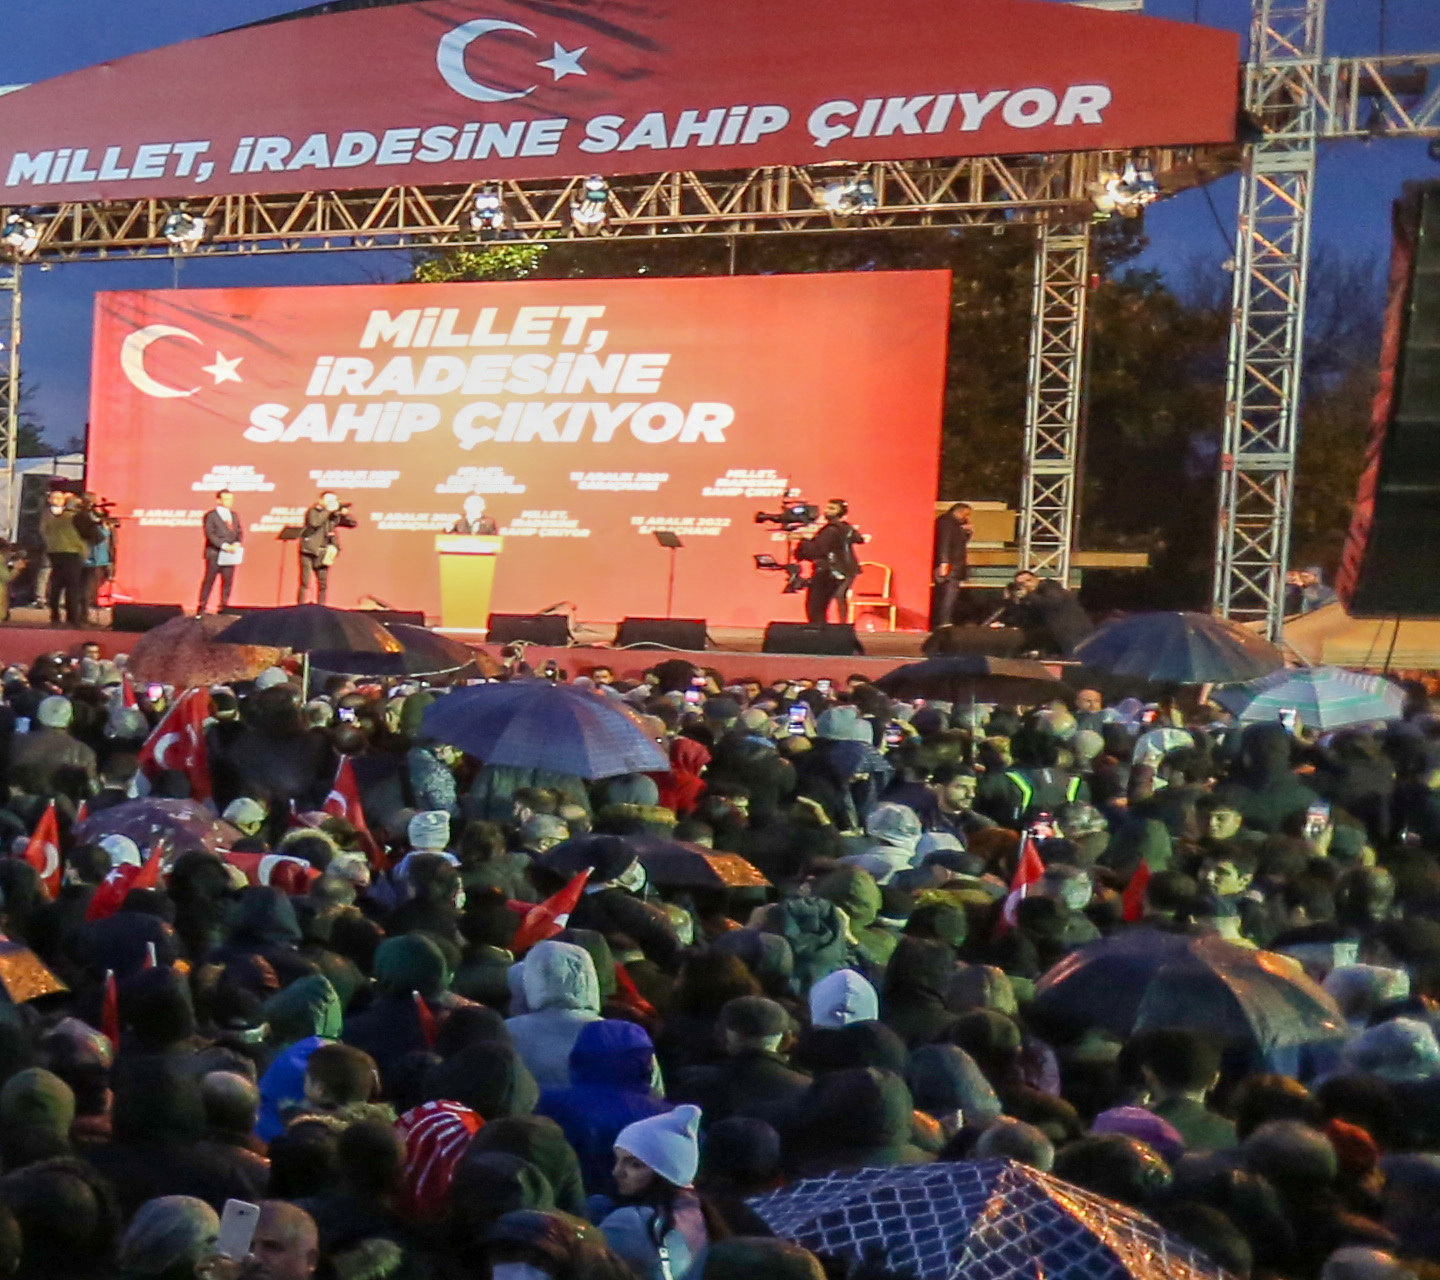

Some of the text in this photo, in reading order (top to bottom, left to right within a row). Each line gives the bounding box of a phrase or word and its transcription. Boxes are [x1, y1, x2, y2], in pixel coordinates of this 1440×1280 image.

[5, 85, 1112, 186] MİLLET, İRADESİNE SAHİP ÇIKIYOR
[360, 305, 609, 352] MİLLET,
[305, 352, 671, 396] İRADESİNE
[243, 401, 735, 451] SAHİP ÇIKIYOR
